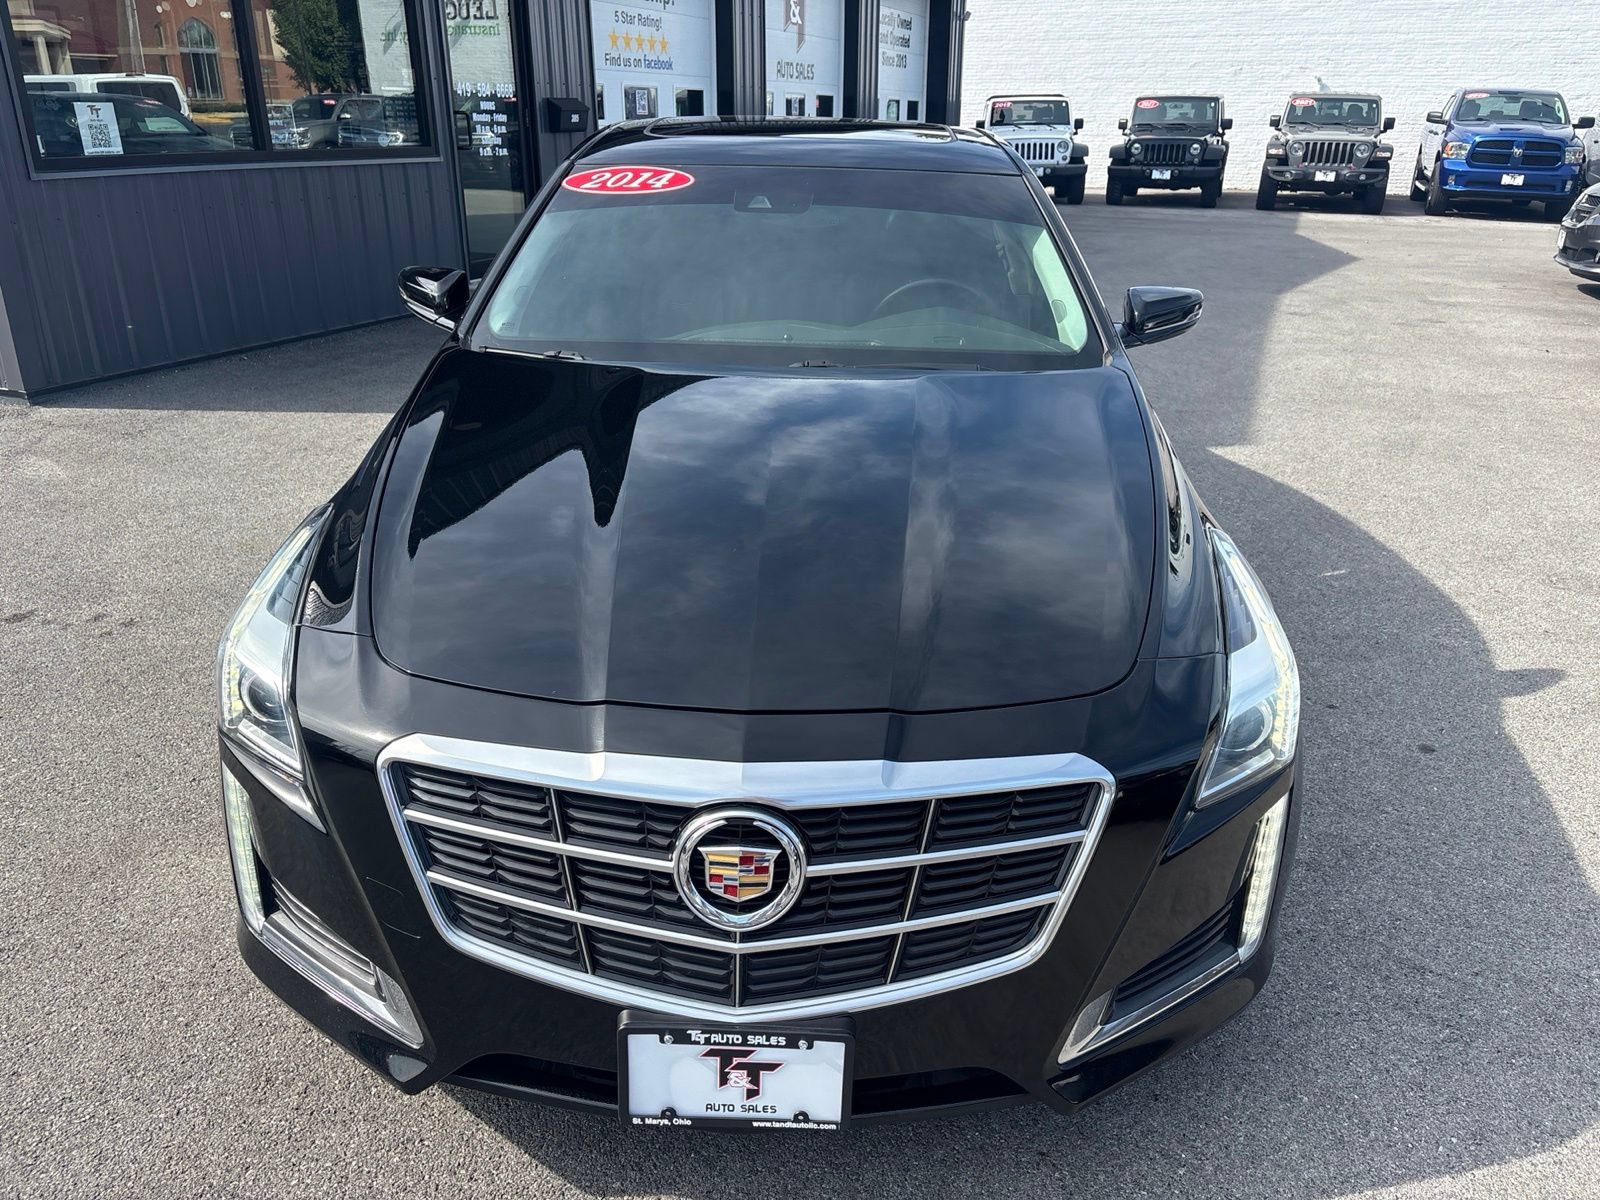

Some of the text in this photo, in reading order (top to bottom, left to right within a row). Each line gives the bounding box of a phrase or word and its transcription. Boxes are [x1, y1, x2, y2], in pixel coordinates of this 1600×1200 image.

[614, 10, 662, 31] 5 Star Rating!
[890, 31, 910, 48] Operated
[604, 52, 674, 70] Find us on facebook
[882, 51, 906, 69] Since 2013
[776, 60, 815, 80] AUTO SALES
[457, 81, 471, 96] 419
[477, 82, 491, 97] 584
[472, 112, 490, 122] Monday
[580, 172, 675, 188] 2014
[710, 1033, 742, 1044] AUTO
[747, 1035, 786, 1046] SALES
[705, 1103, 777, 1114] AUTO SALES
[672, 1118, 692, 1126] Ohio
